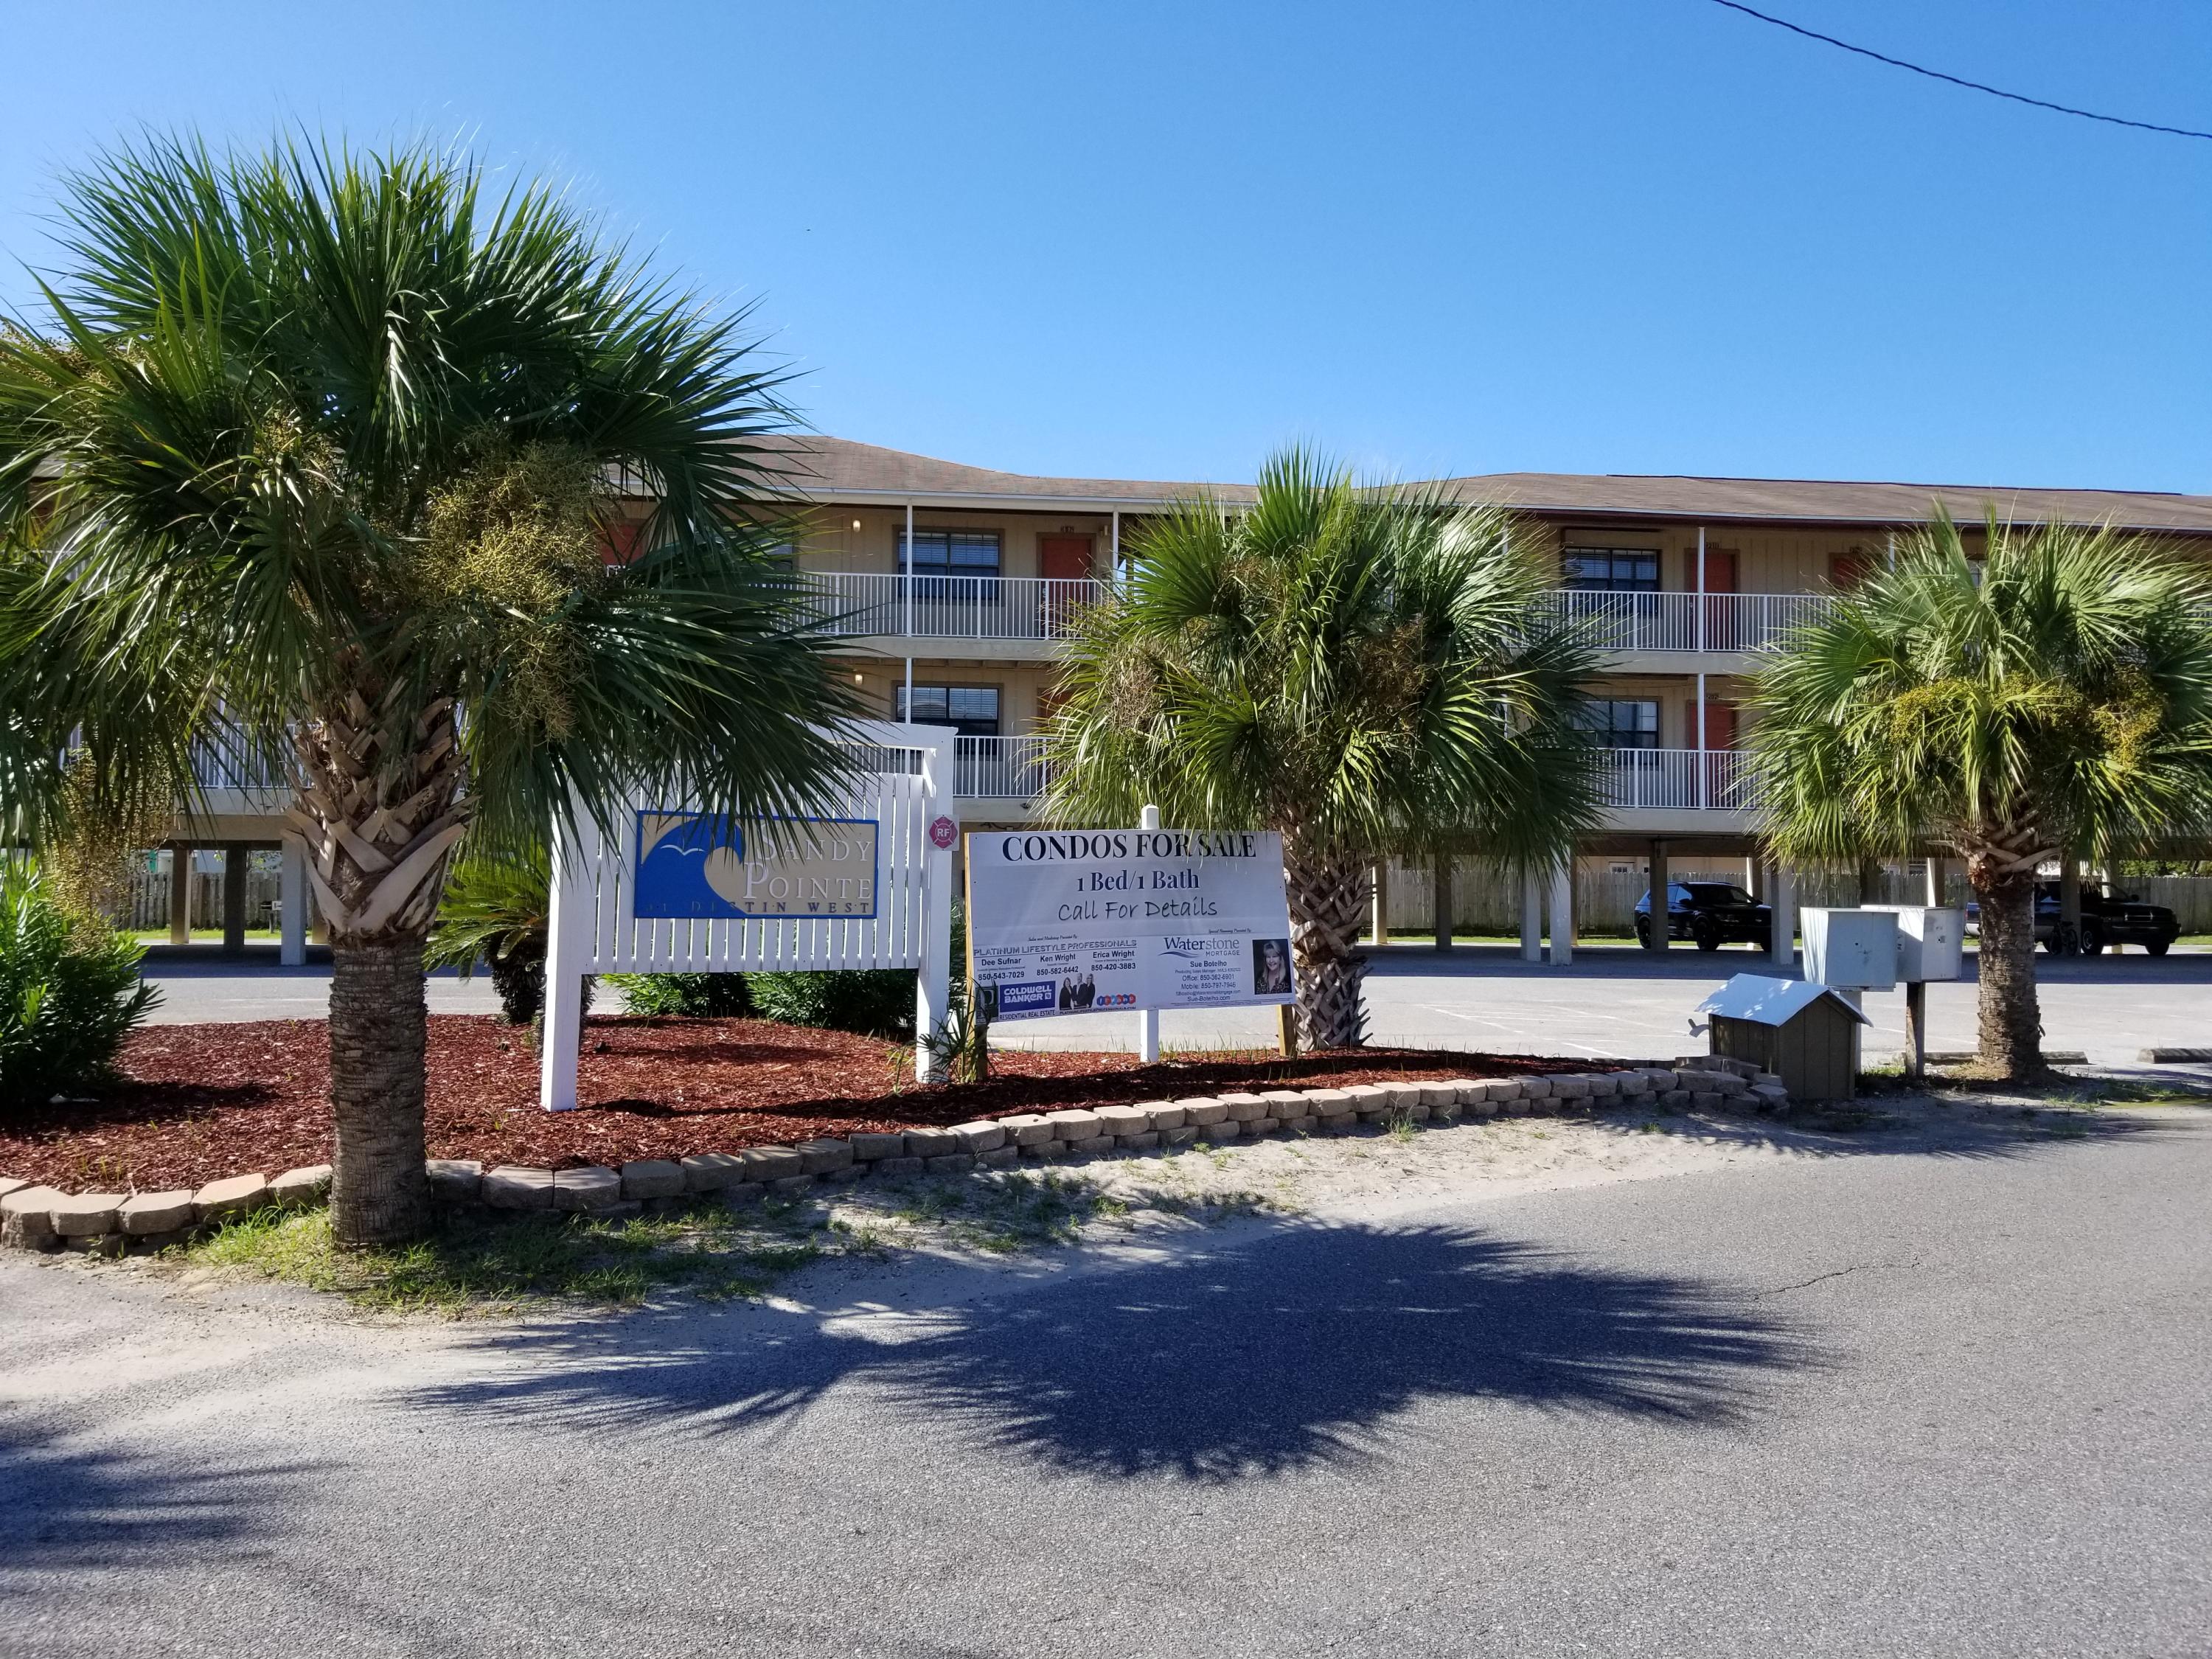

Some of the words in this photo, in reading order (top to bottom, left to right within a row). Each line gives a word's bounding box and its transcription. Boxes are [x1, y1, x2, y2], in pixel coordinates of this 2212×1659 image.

[937, 828, 950, 837] RF
[757, 824, 872, 861] SANDY
[1002, 834, 1127, 862] CONDOS
[1135, 833, 1192, 858] FOR
[1198, 834, 1256, 858] SALE
[742, 862, 872, 900] POINTE
[1077, 877, 1084, 891] 1
[1091, 869, 1144, 891] Bed/1
[1152, 869, 1200, 890] Bath
[808, 902, 869, 914] WEST
[1058, 900, 1098, 921] Call
[1105, 901, 1138, 919] For
[1145, 897, 1218, 917] Details
[974, 947, 1020, 957] PLATINUM
[1022, 943, 1066, 954] LIFESTYLE
[1068, 939, 1137, 950] PROFESSIONALS
[1164, 936, 1240, 950] Waterstone
[1054, 953, 1077, 962] Wright
[1112, 950, 1135, 959] Wright
[1037, 966, 1079, 975] 850-582-6442
[1091, 962, 1136, 972] 850-420-3883
[978, 970, 1025, 981] 850-543-7029
[999, 1012, 1027, 1020] RESIDENTIAL
